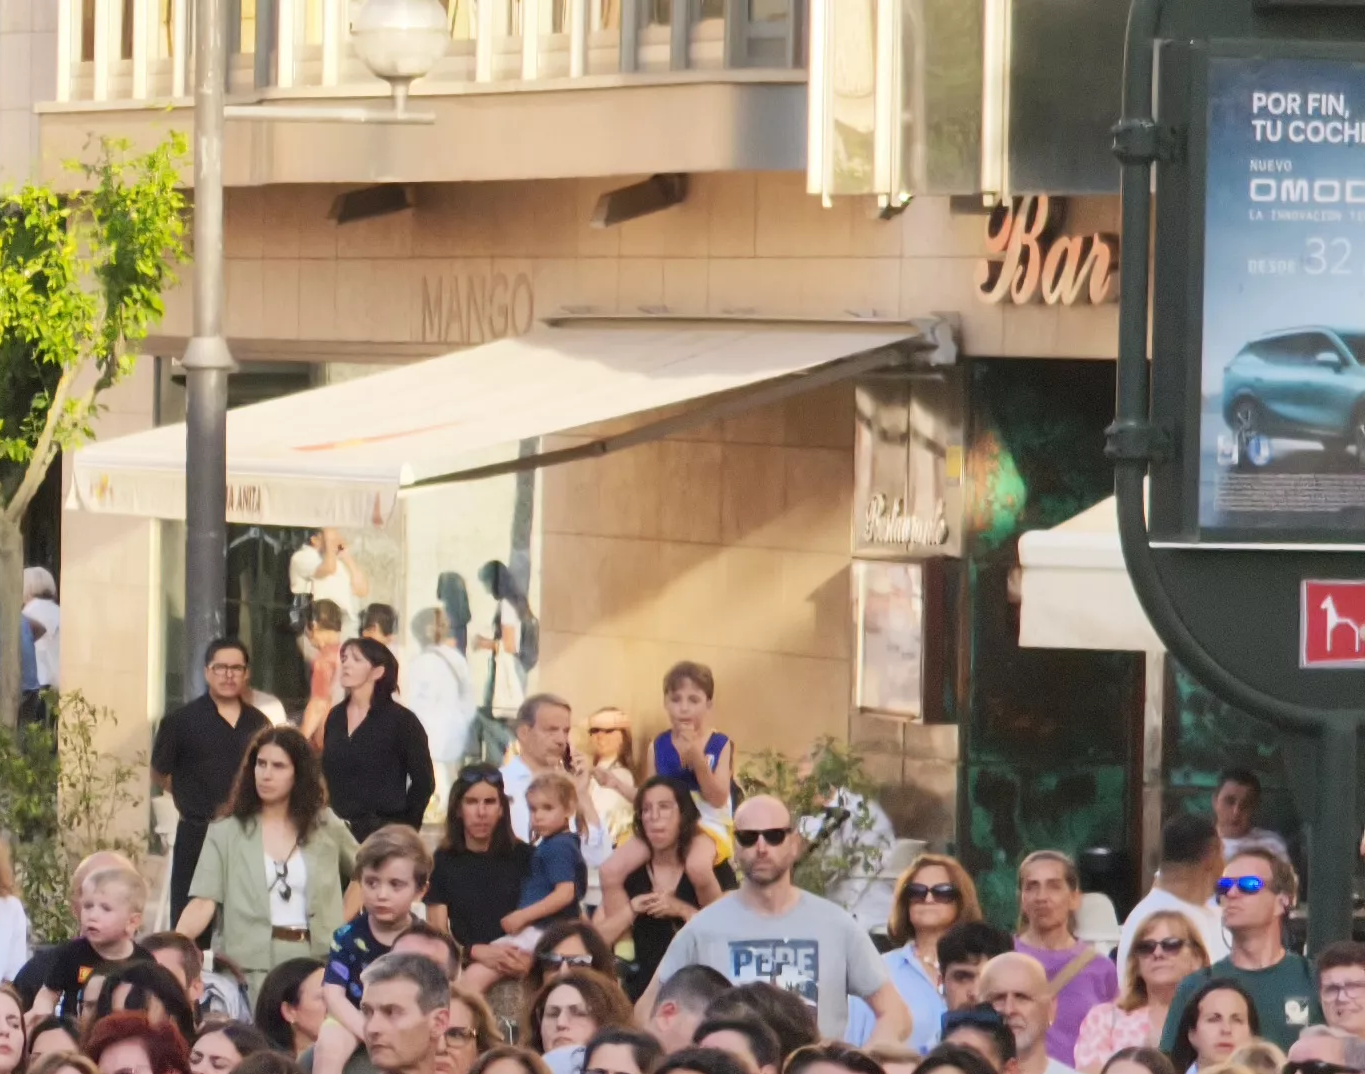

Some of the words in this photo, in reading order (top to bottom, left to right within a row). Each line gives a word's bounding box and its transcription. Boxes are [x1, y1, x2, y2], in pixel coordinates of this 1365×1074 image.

[1252, 92, 1301, 115] POR
[1307, 92, 1349, 120] FIN,
[1251, 119, 1282, 142] TU
[1249, 159, 1293, 172] NUEVO
[1249, 209, 1263, 221] LA
[974, 194, 1111, 305] Bar
[421, 271, 535, 343] MANGO
[732, 946, 816, 979] PEPE
